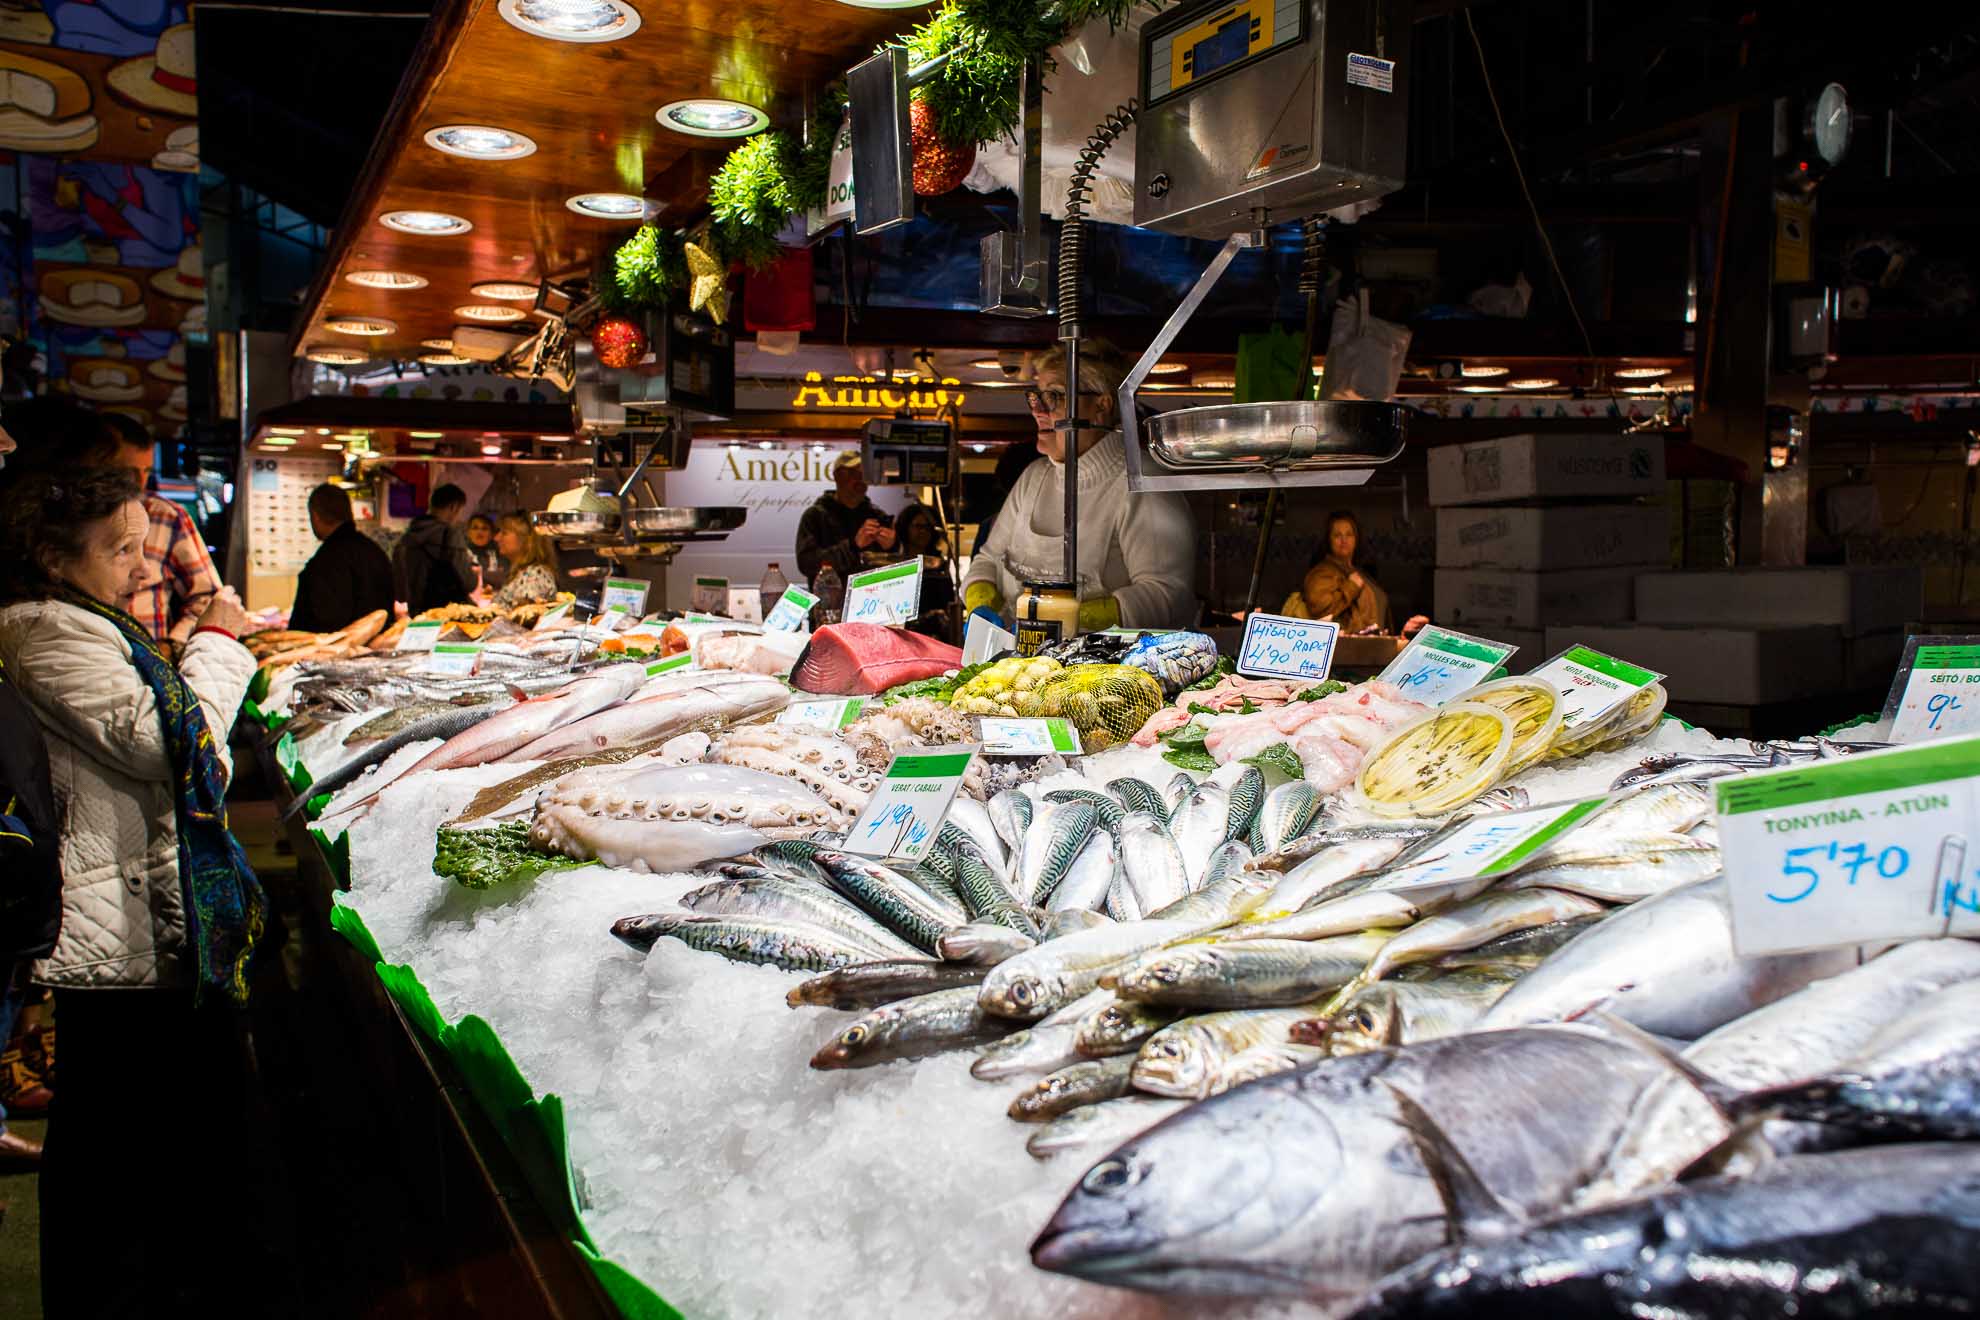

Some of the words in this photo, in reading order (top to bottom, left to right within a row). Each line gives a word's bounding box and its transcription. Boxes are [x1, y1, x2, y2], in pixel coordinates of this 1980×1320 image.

[1019, 630, 1048, 644] FUMET
[1248, 643, 1290, 667] 4'90
[1424, 651, 1449, 664] MOLLES
[1460, 660, 1477, 670] RAP
[1930, 673, 1959, 683] SEITÓ
[891, 783, 911, 792] VERAT
[914, 783, 942, 792] CABALLA
[1764, 806, 1865, 834] TONYINA
[1884, 794, 1950, 817] ATÚN
[1766, 840, 1910, 904] 5'70
